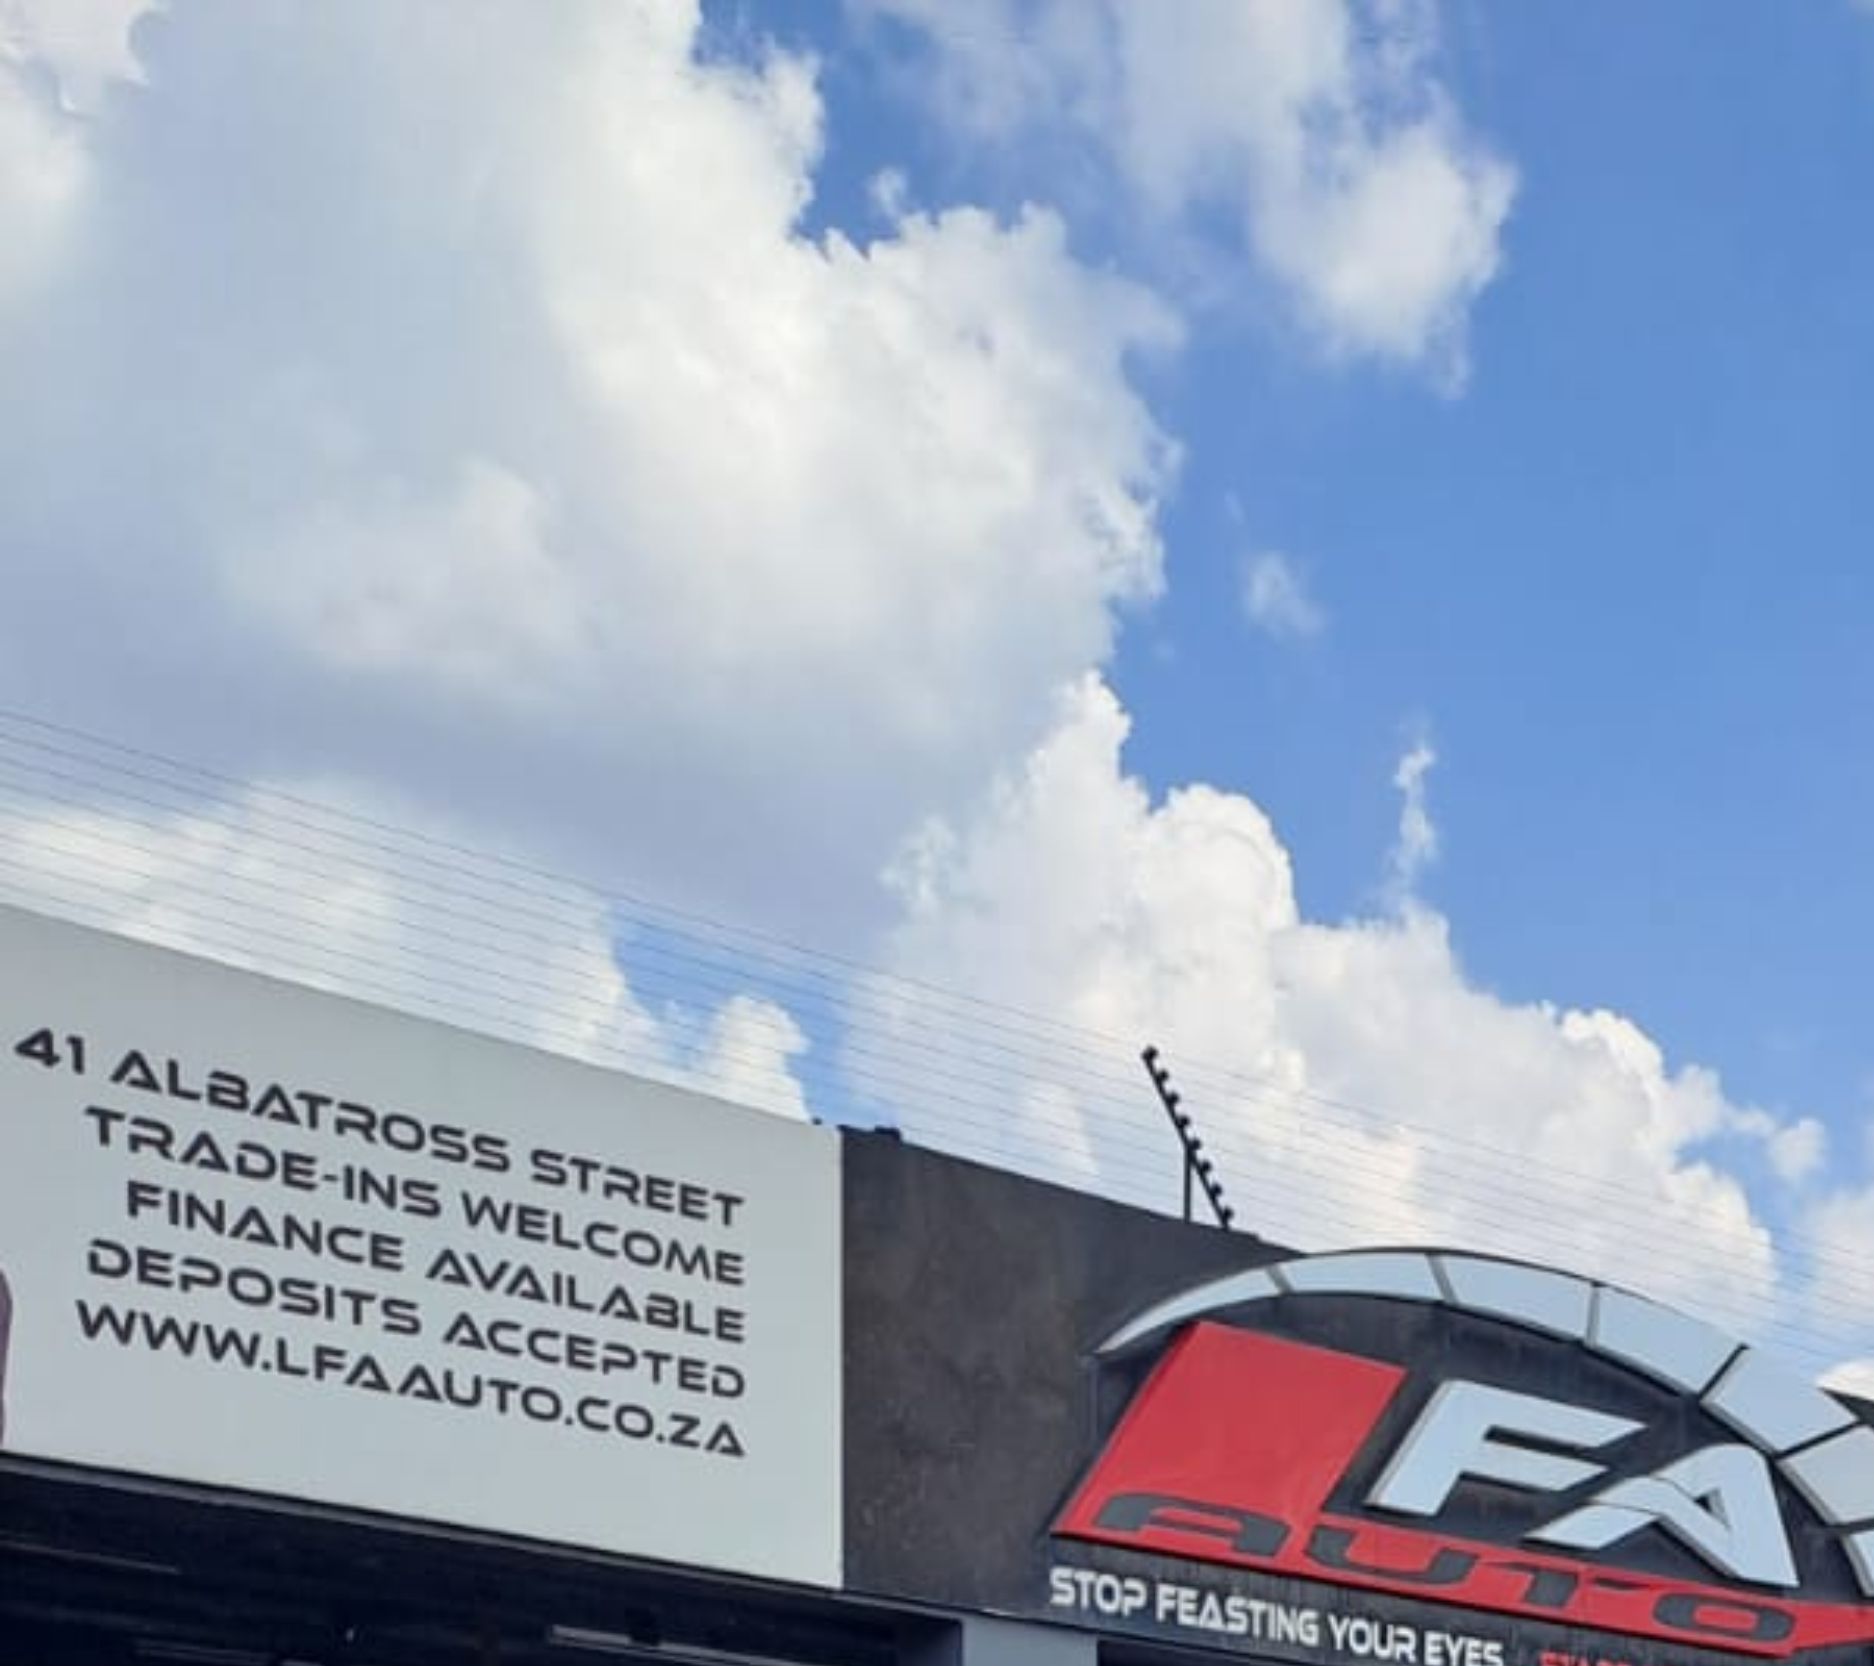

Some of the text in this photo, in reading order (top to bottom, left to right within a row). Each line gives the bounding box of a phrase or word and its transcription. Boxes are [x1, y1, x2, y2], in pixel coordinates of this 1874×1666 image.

[14, 1028, 745, 1228] 41 ALBATROSS STREET
[85, 1105, 746, 1287] TRADE-INS WELCOME
[87, 1238, 746, 1399] DEPOSITS ACCEPTED
[127, 1180, 746, 1343] FINANCE AVAILABLE
[75, 1298, 746, 1457] WWW.LFAAUTO.CO.ZA
[1049, 1566, 1147, 1617] STOP
[1155, 1582, 1320, 1647] FEASTING
[1328, 1613, 1417, 1666] YOUR
[1095, 1492, 1797, 1646] AUTO
